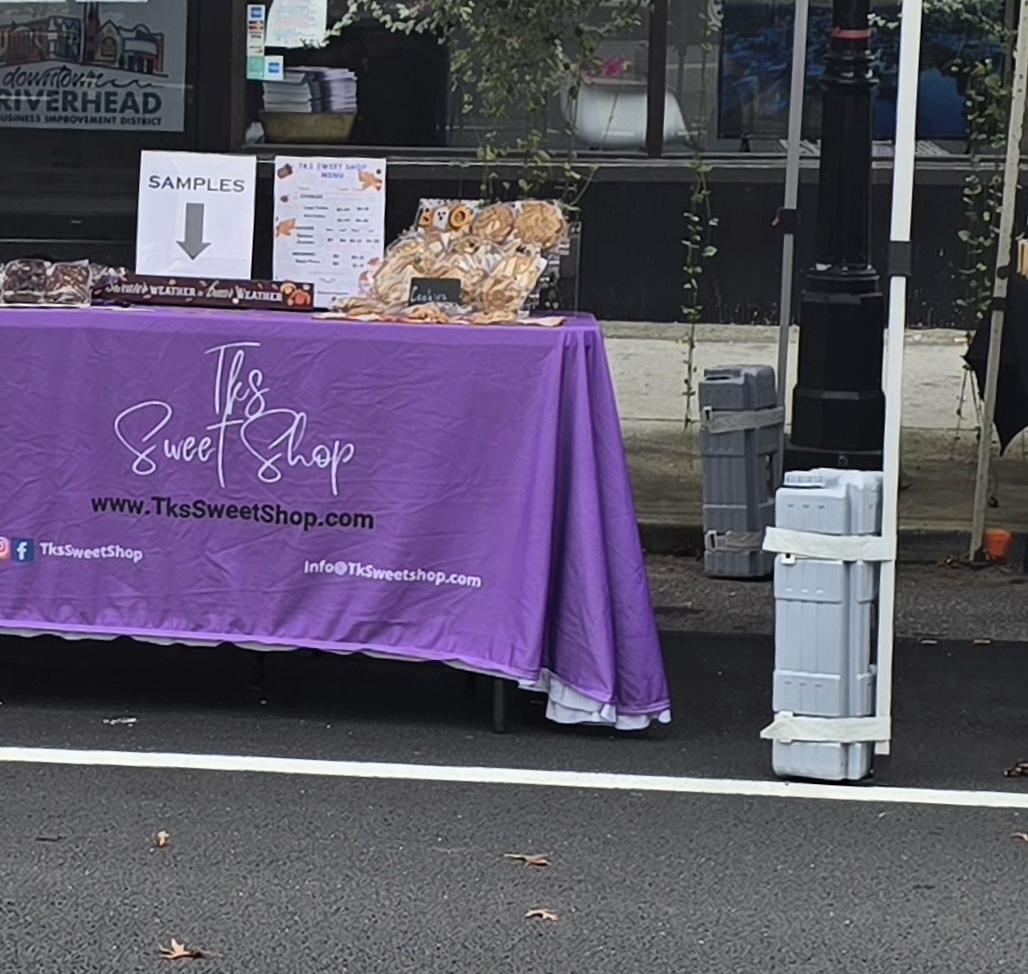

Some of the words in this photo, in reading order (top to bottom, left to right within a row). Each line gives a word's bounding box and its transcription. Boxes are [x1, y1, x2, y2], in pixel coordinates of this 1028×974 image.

[45, 115, 117, 125] IMPROVEMENT
[120, 116, 162, 126] DISTRICT
[148, 175, 245, 192] SAMPLES
[204, 342, 269, 419] Tks
[114, 400, 242, 488] Sweet
[240, 408, 355, 496] Shop
[91, 496, 374, 530] www.TksSweetShop.com
[39, 542, 143, 563] TksSweetShop
